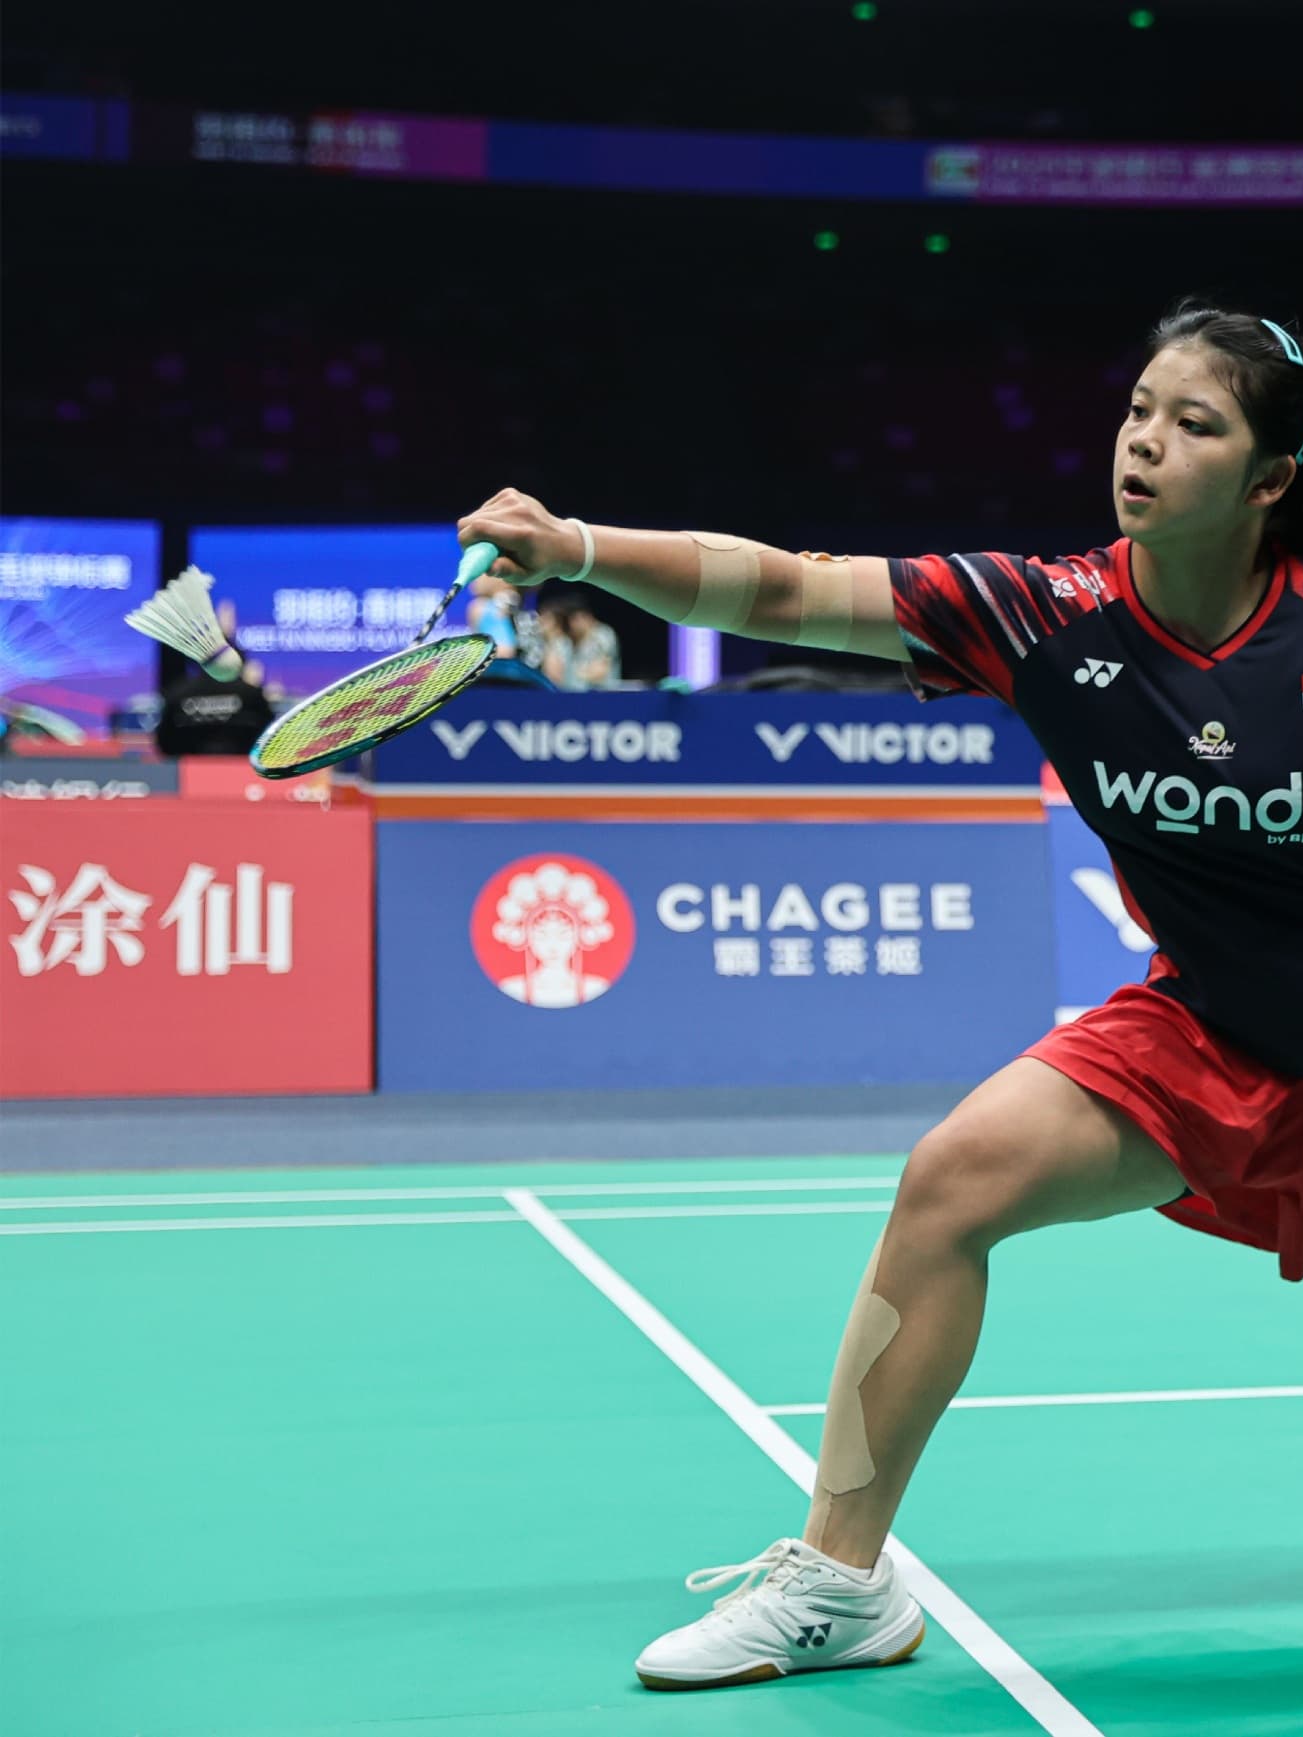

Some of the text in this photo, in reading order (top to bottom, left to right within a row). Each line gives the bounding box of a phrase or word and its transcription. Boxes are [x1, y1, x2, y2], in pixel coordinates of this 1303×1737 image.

[494, 719, 682, 763] VICTOR
[814, 722, 995, 765] VICTOR
[1267, 834, 1288, 845] by
[8, 861, 295, 977] 涂仙
[656, 882, 975, 933] CHAGEE
